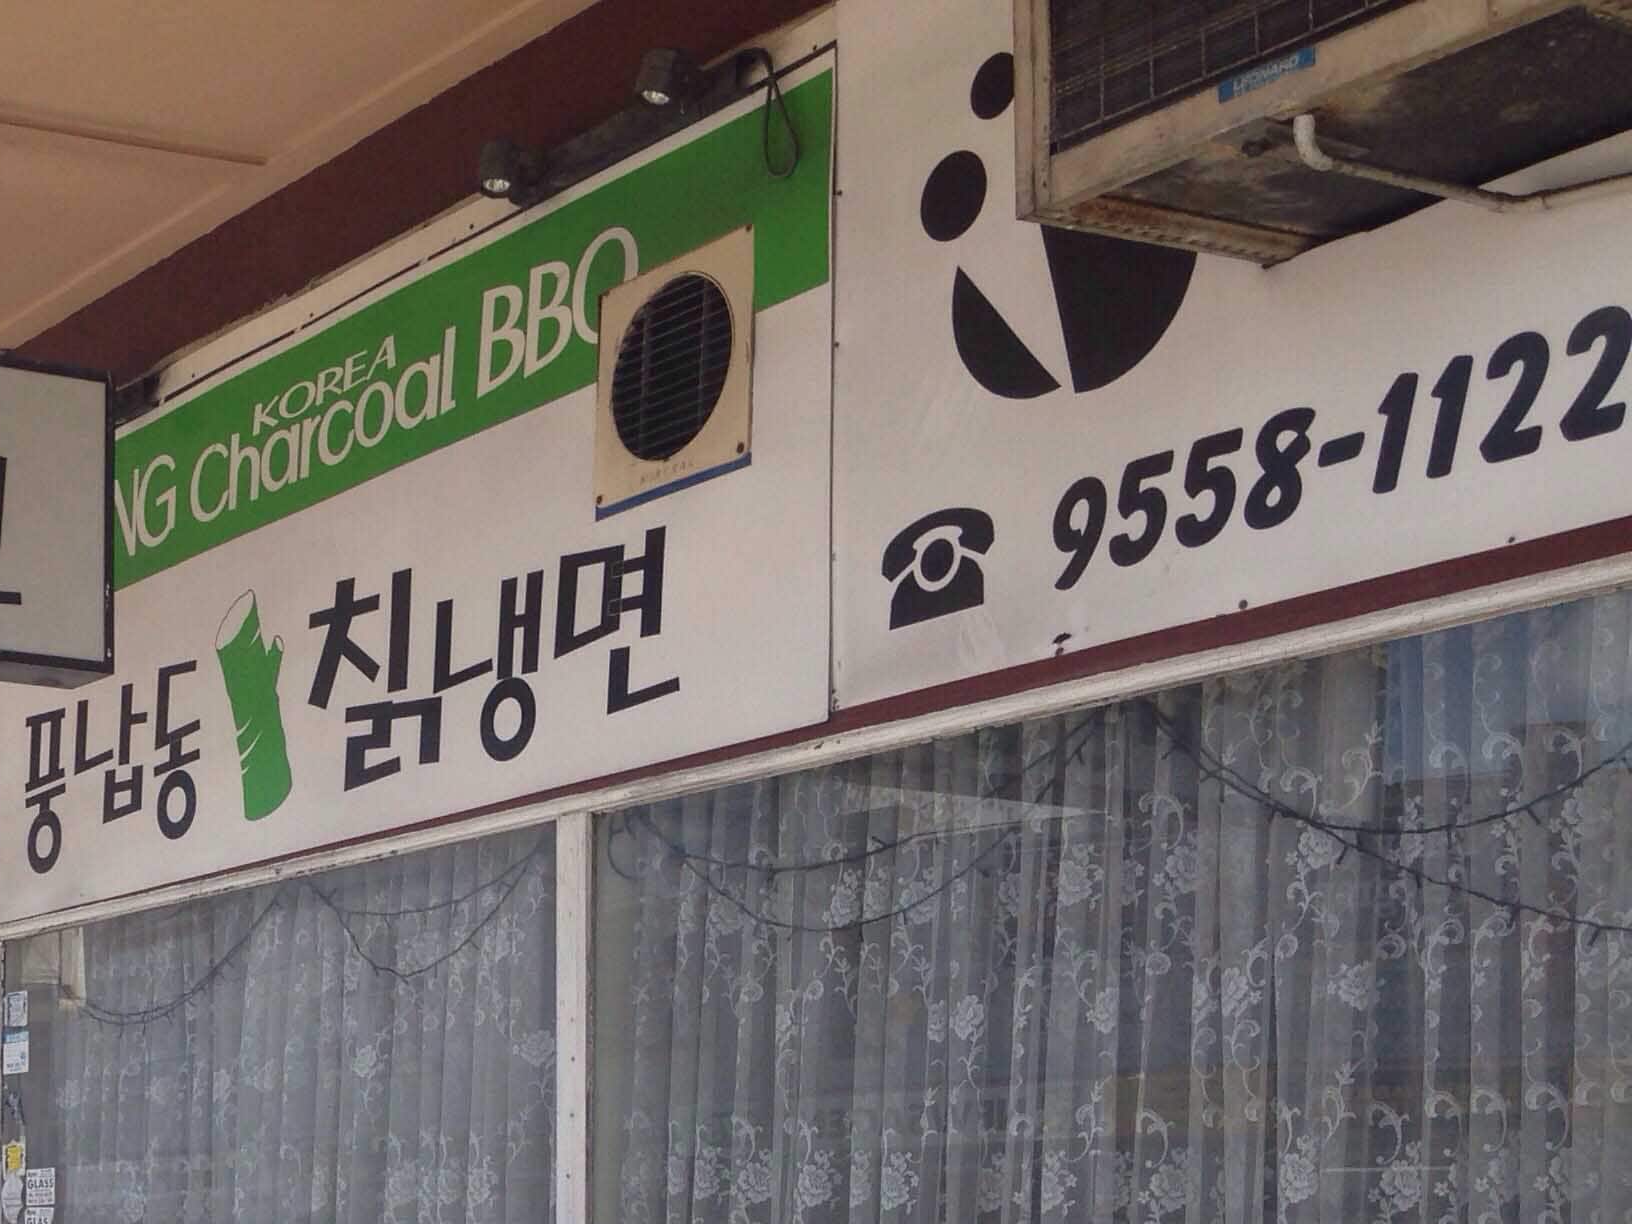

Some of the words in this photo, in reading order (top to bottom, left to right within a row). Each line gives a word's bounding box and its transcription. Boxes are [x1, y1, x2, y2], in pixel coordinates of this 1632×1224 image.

[190, 325, 457, 522] Charcoal
[252, 334, 397, 436] KOREA
[1052, 304, 1632, 592] 9558-1122
[24, 659, 201, 875] 풍납동
[307, 525, 681, 793] 칡냉면
